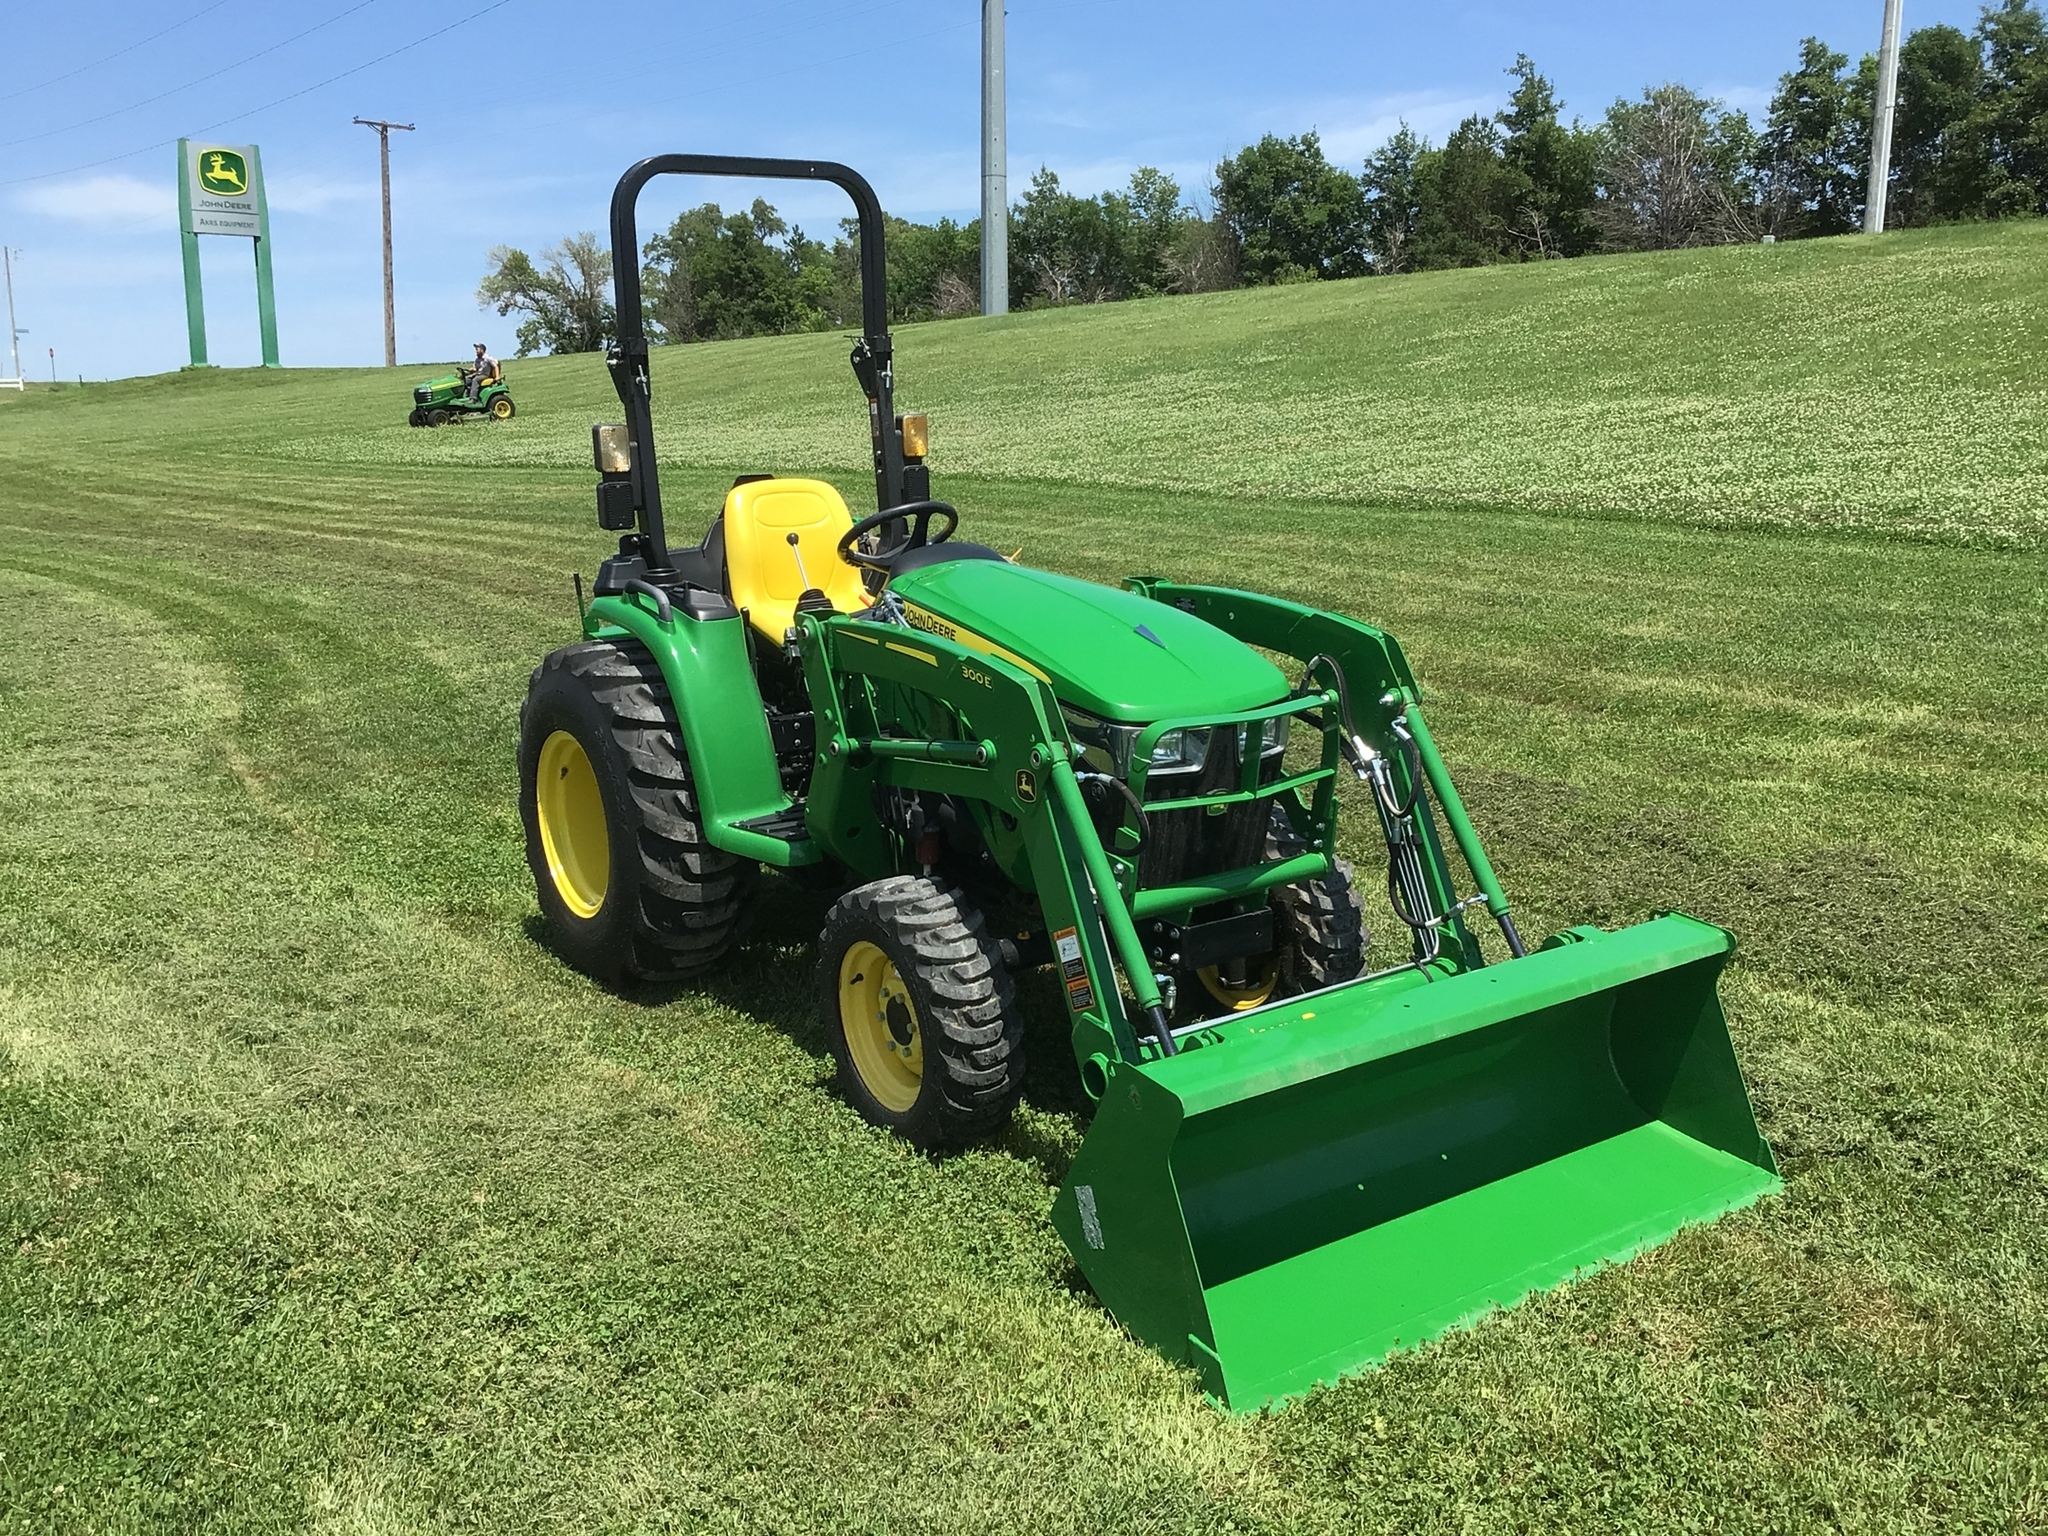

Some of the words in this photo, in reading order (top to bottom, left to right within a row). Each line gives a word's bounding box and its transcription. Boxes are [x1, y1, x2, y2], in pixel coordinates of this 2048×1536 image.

[199, 200, 223, 208] JOHN
[223, 201, 252, 210] DEERE
[904, 606, 926, 629] JOHN
[926, 615, 956, 641] DEERE
